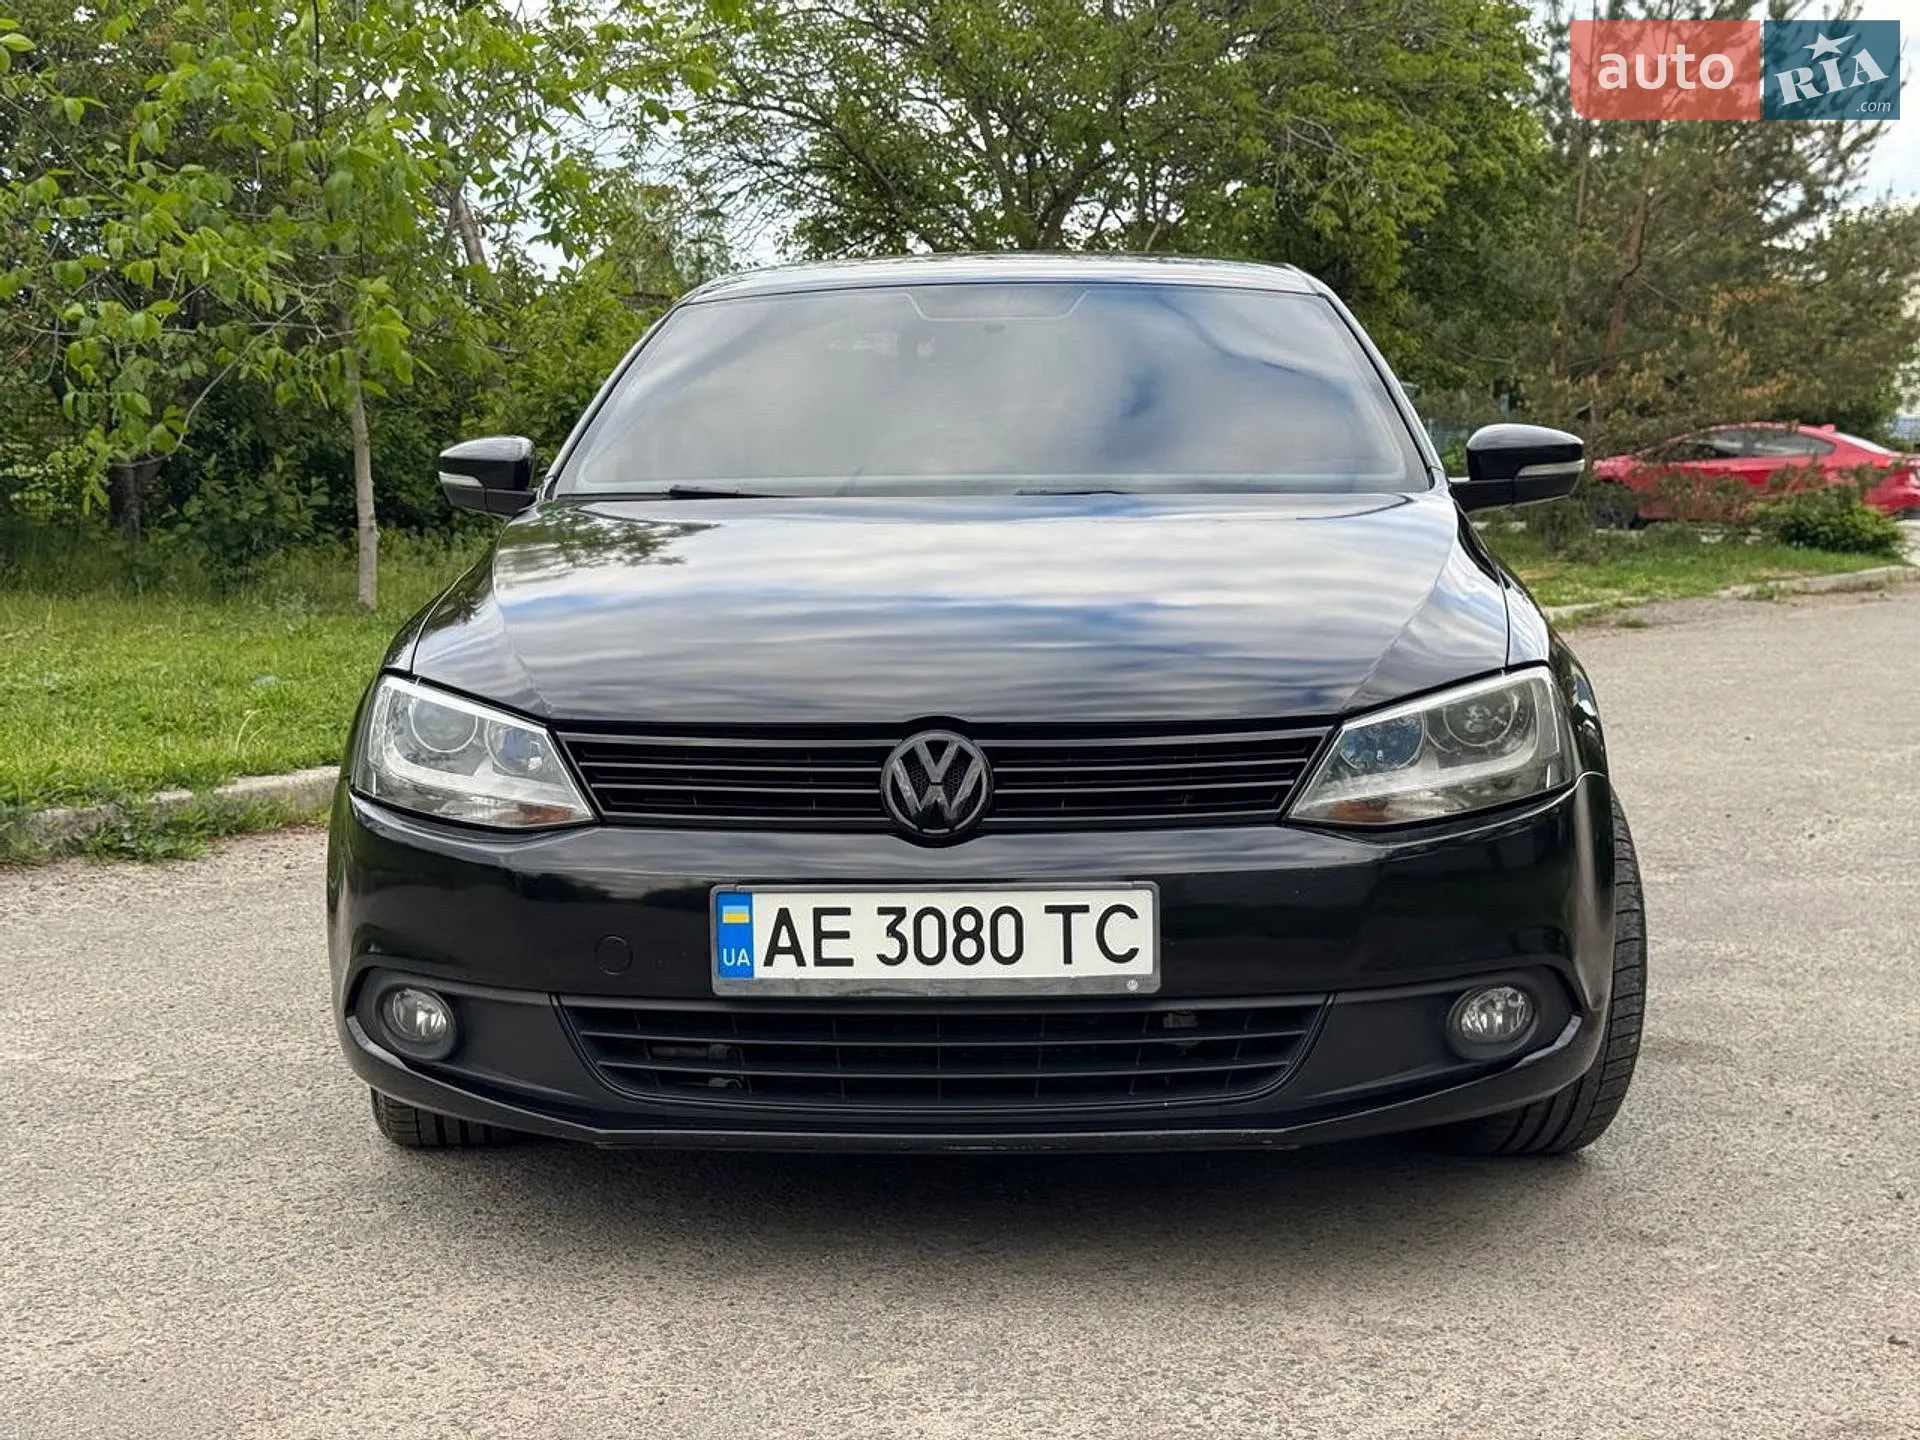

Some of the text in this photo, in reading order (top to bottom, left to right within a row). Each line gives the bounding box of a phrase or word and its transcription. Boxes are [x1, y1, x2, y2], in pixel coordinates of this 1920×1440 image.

[762, 903, 1140, 967] AE 3080 TC
[722, 948, 750, 967] UA
